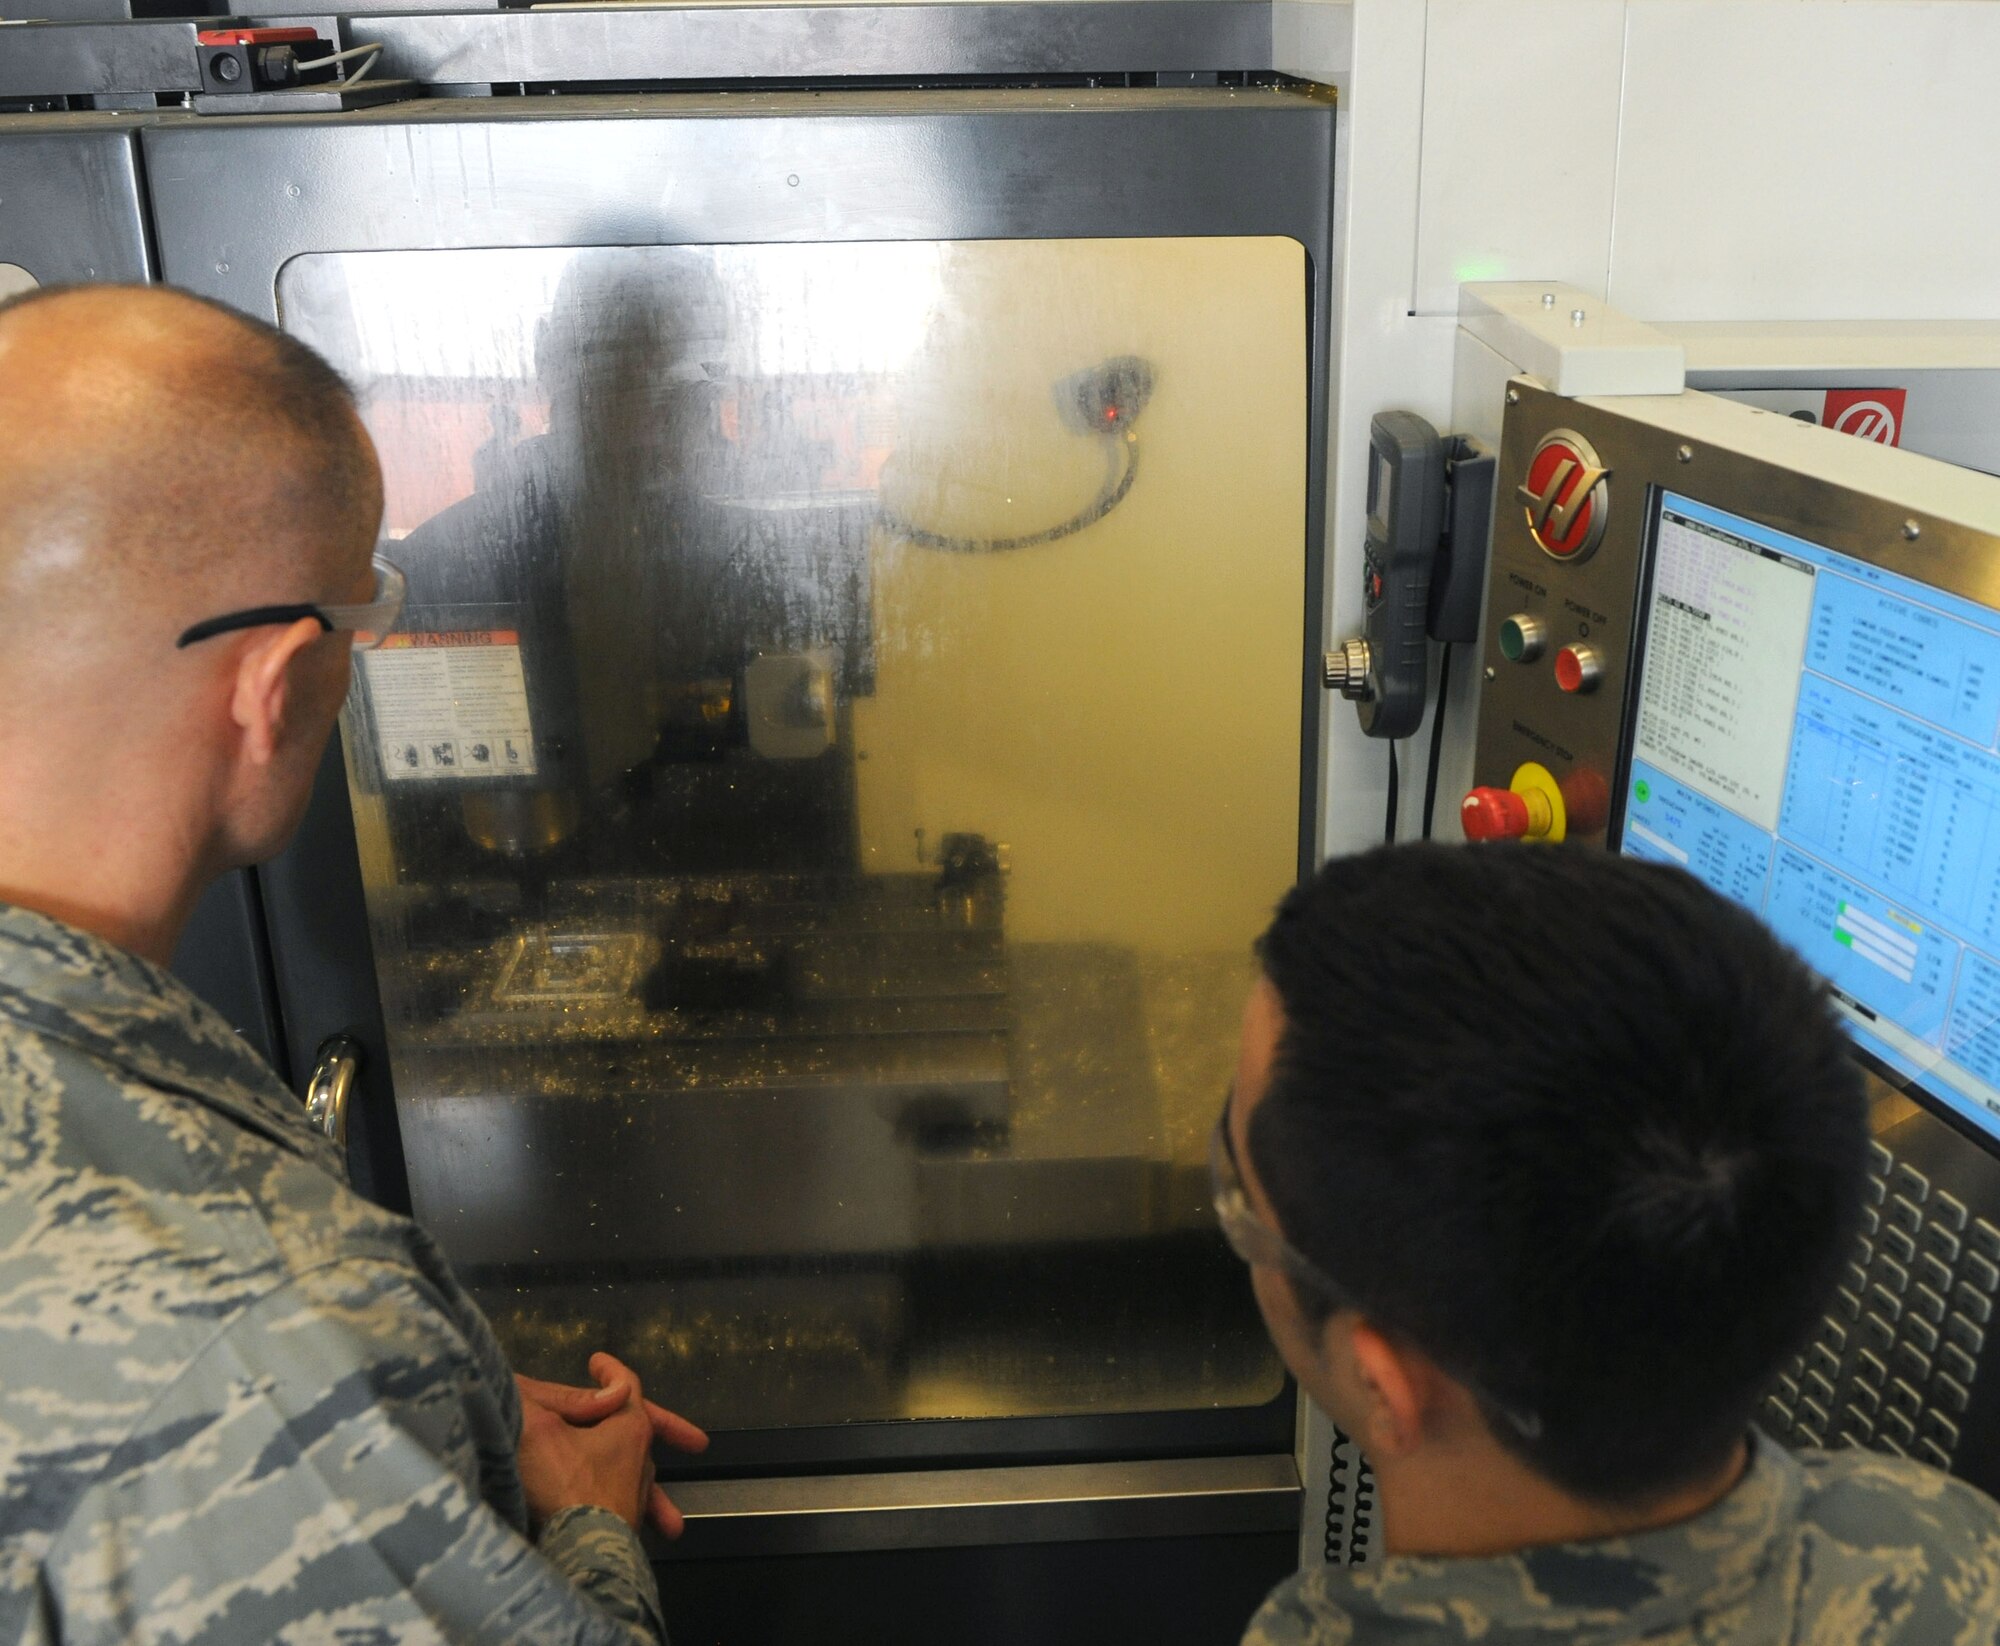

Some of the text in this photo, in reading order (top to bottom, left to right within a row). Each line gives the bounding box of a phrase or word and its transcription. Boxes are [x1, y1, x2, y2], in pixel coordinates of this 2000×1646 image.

[1509, 573, 1547, 597] POWER ON
[1564, 598, 1608, 625] POWER OFF
[410, 631, 493, 647] WARNING
[1556, 745, 1574, 761] STOP
